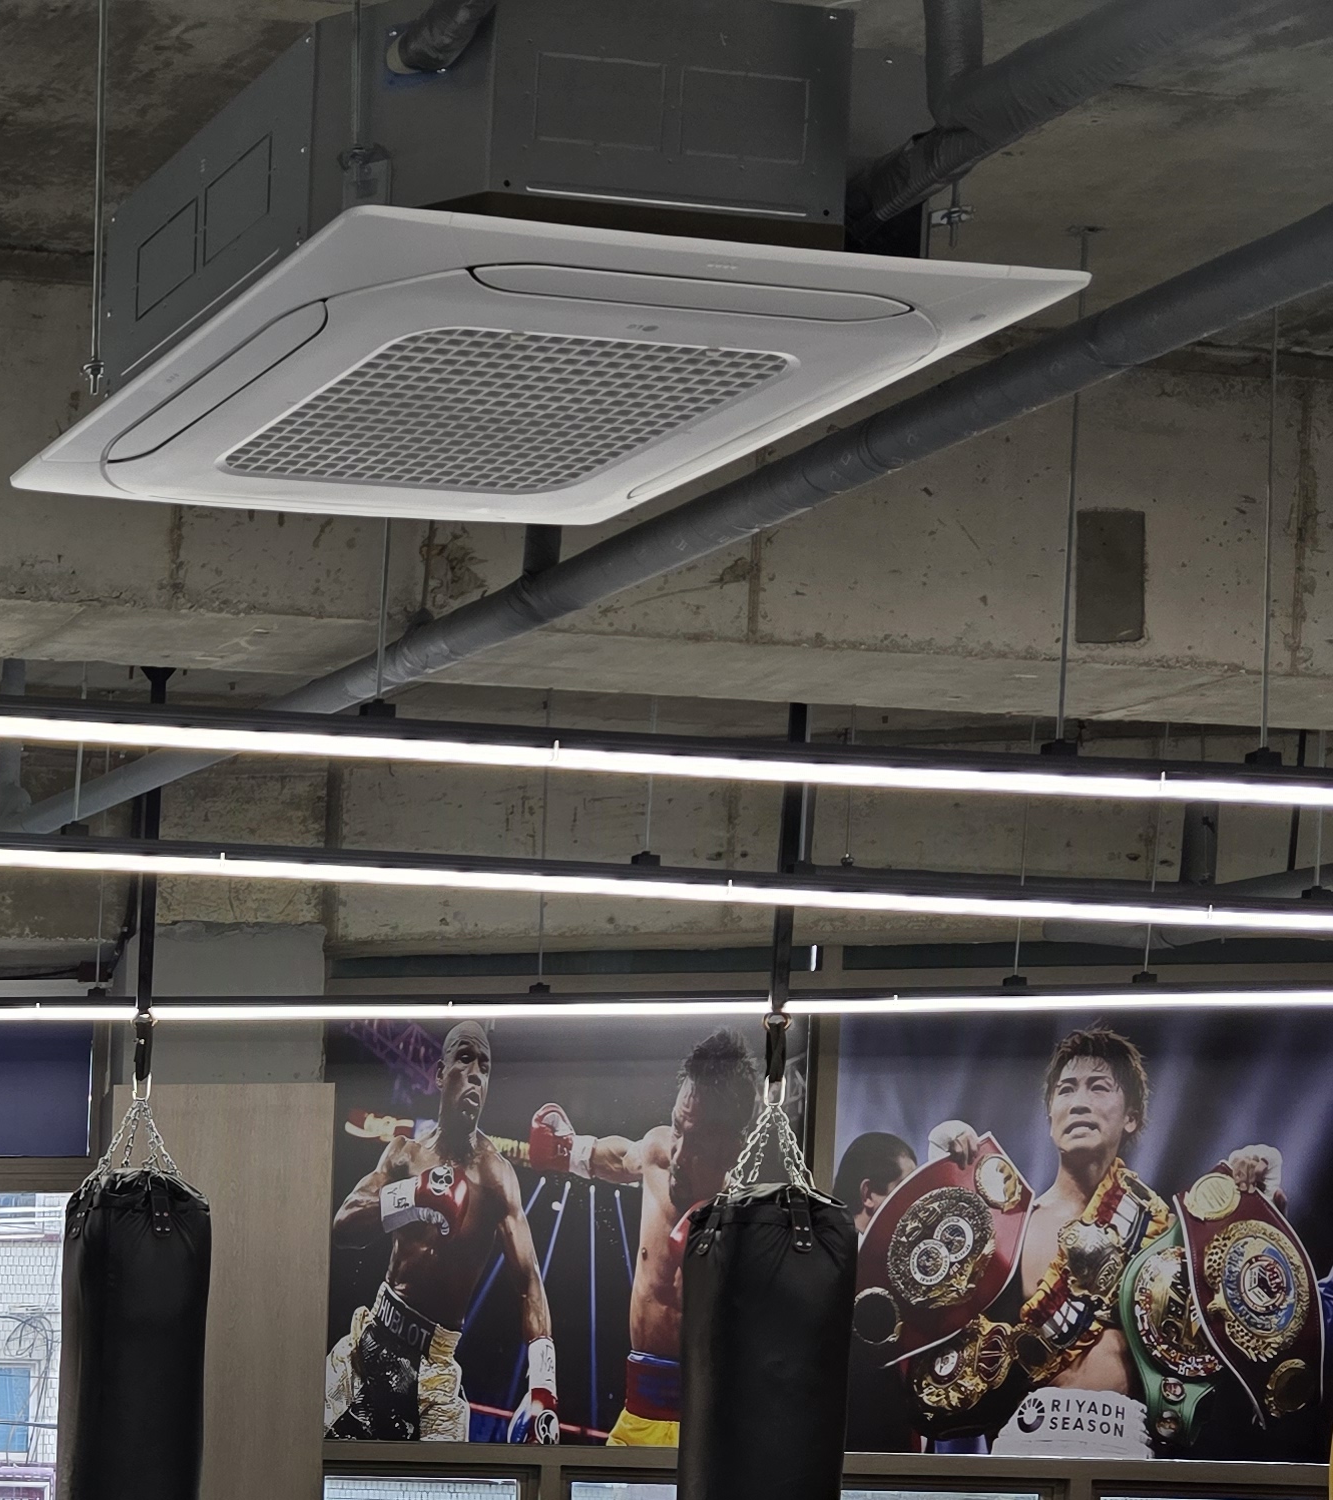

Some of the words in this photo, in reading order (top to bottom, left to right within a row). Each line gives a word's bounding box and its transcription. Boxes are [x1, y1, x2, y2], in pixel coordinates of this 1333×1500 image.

[377, 1294, 432, 1351] HUBLOT
[1051, 1399, 1126, 1420] RIYADH
[1049, 1416, 1125, 1438] SEASON
